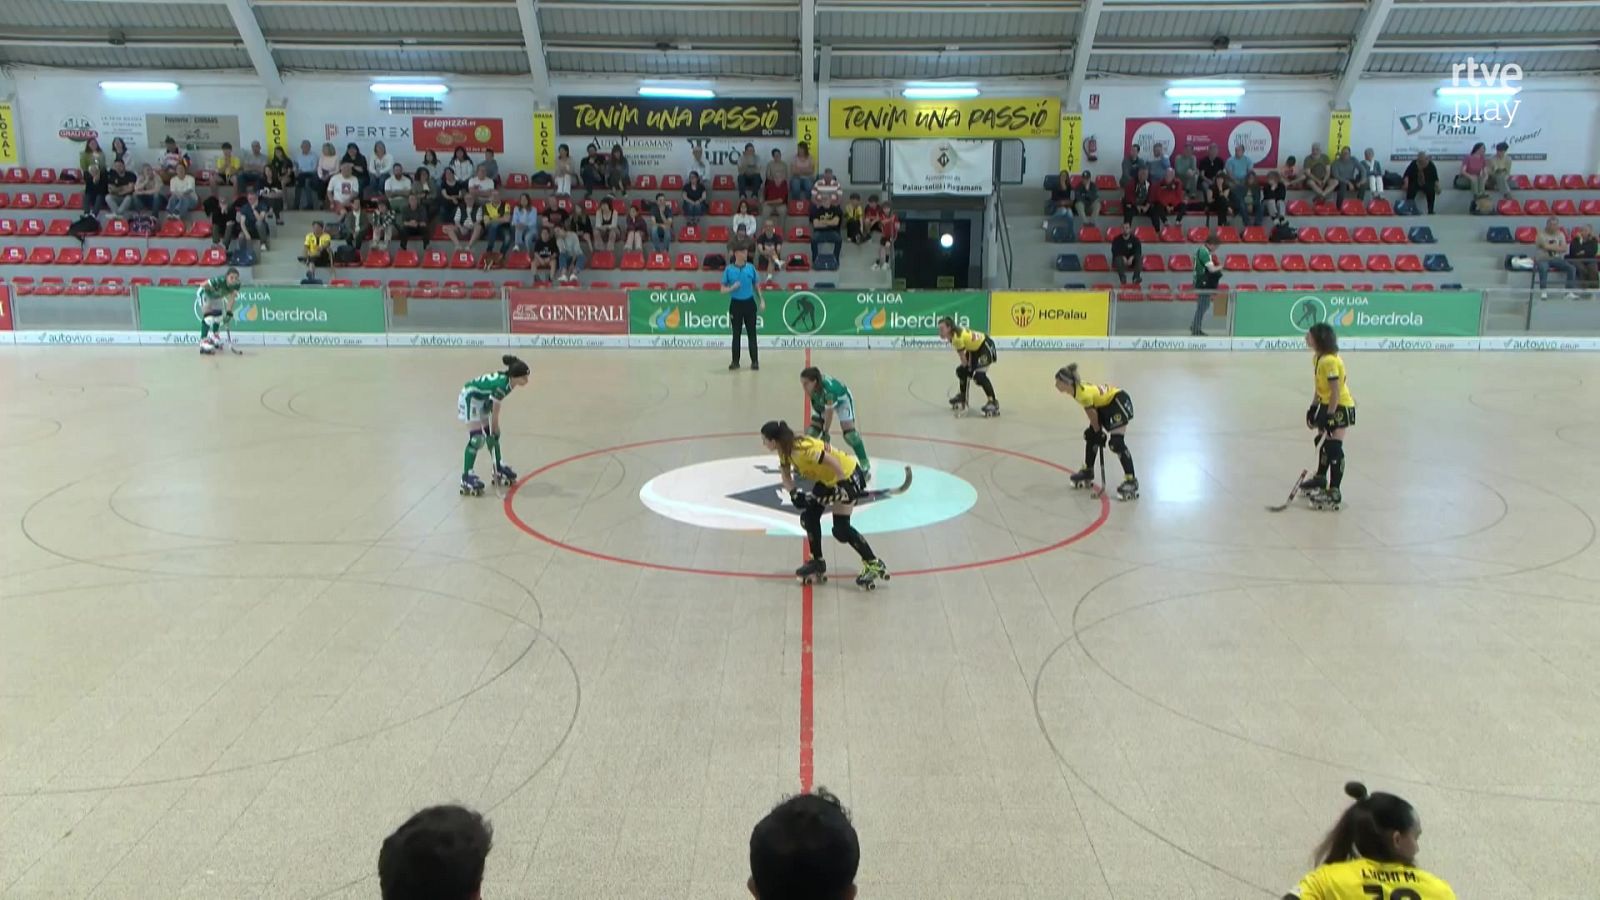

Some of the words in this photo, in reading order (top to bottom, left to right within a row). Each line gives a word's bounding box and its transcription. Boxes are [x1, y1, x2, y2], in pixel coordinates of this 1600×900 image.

[272, 119, 281, 145] LOC
[345, 128, 410, 138] PERTEX
[1436, 124, 1477, 136] Palau
[540, 121, 549, 165] LOCAL
[249, 291, 271, 301] LIGA
[650, 292, 667, 303] OK
[670, 292, 697, 303] LIGA
[857, 293, 874, 304] OK
[876, 293, 903, 304] LIGA
[1330, 296, 1345, 306] OK
[1346, 296, 1369, 306] LIGA
[261, 306, 328, 322] Iberdrola
[539, 304, 625, 322] GENERALI
[684, 311, 764, 328] Iberda
[890, 312, 970, 329] Iberdrla
[1356, 312, 1423, 326] Iberdrola
[48, 333, 92, 344] autovivo
[298, 334, 340, 345] autovivo
[420, 335, 462, 346] autovivo
[541, 336, 583, 346] autovivo
[661, 336, 703, 347] autovivo
[781, 336, 823, 347] autovivo
[1021, 338, 1063, 348] autovivo
[1142, 338, 1185, 349] autovivo
[1513, 339, 1557, 349] autovivo
[1388, 339, 1432, 350] autovivo
